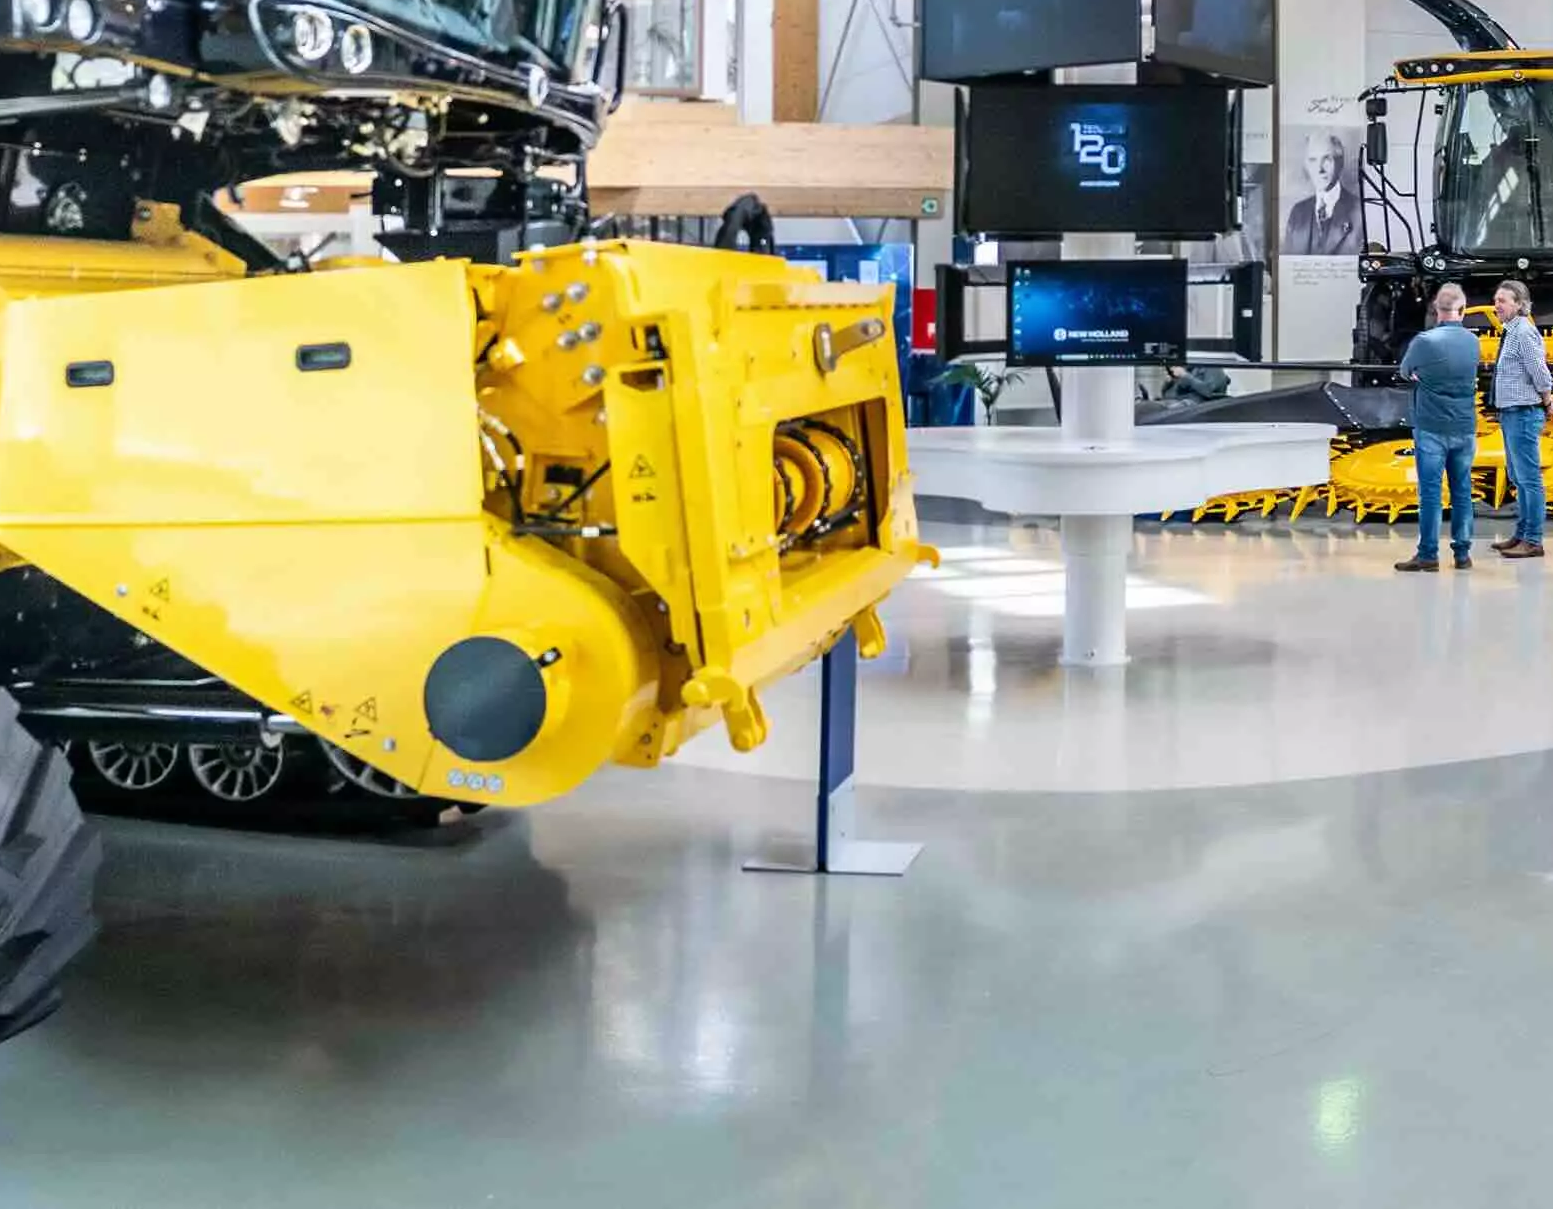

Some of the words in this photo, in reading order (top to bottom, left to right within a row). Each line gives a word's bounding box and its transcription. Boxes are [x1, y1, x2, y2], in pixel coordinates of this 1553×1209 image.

[1070, 122, 1126, 175] 120
[1068, 330, 1088, 338] NEW
[1088, 329, 1129, 338] HOLLAND
